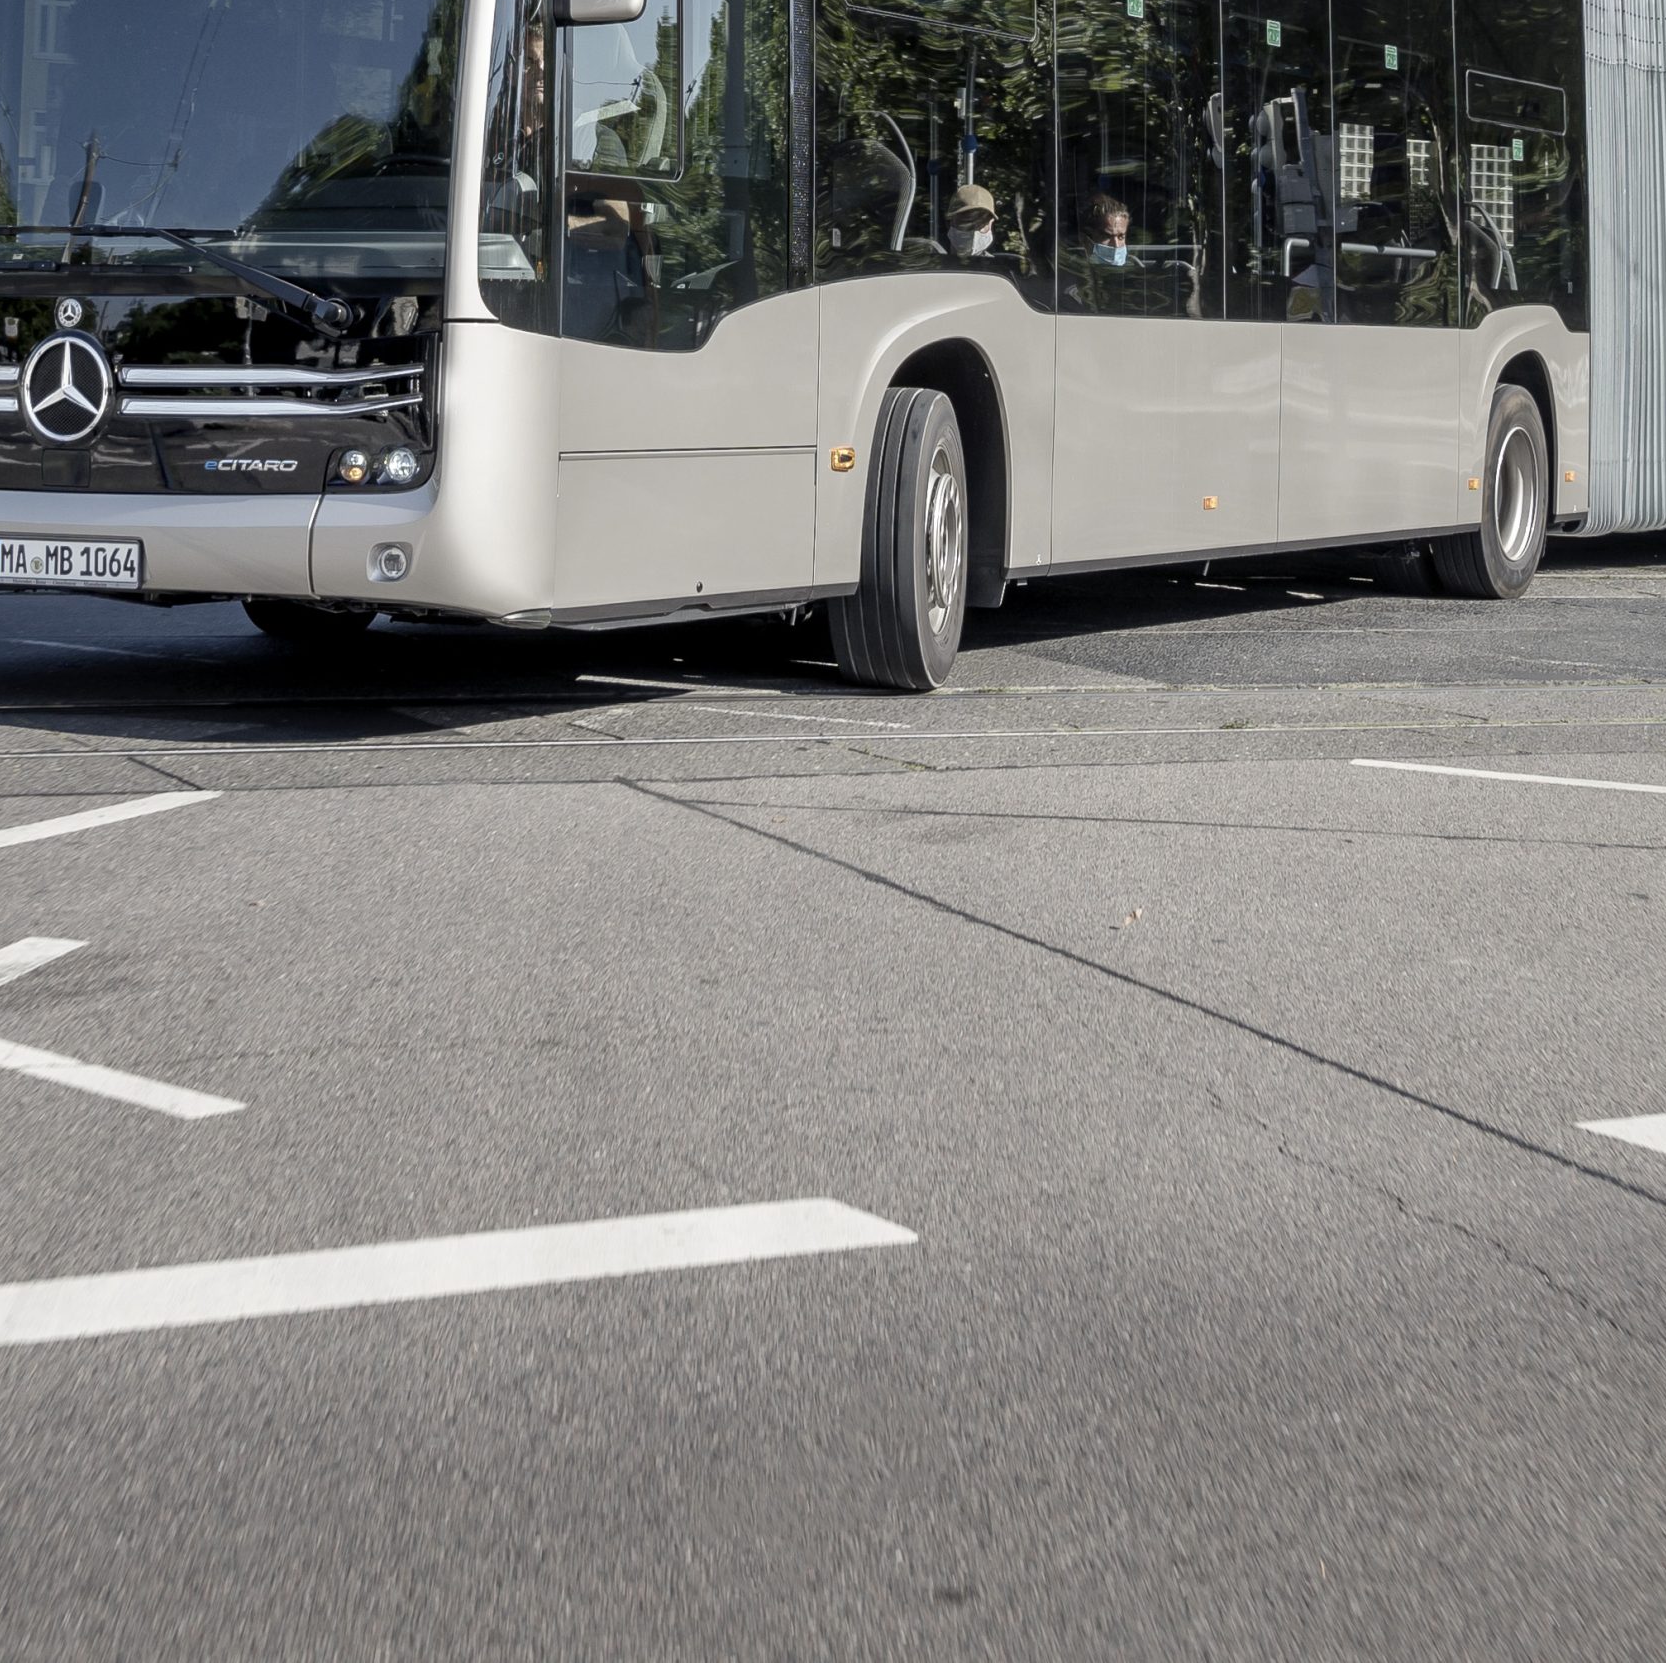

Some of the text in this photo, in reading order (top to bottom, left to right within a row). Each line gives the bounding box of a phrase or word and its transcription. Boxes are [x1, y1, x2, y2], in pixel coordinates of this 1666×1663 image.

[205, 460, 298, 471] eCITARO
[1, 544, 136, 578] MA MB 1064
